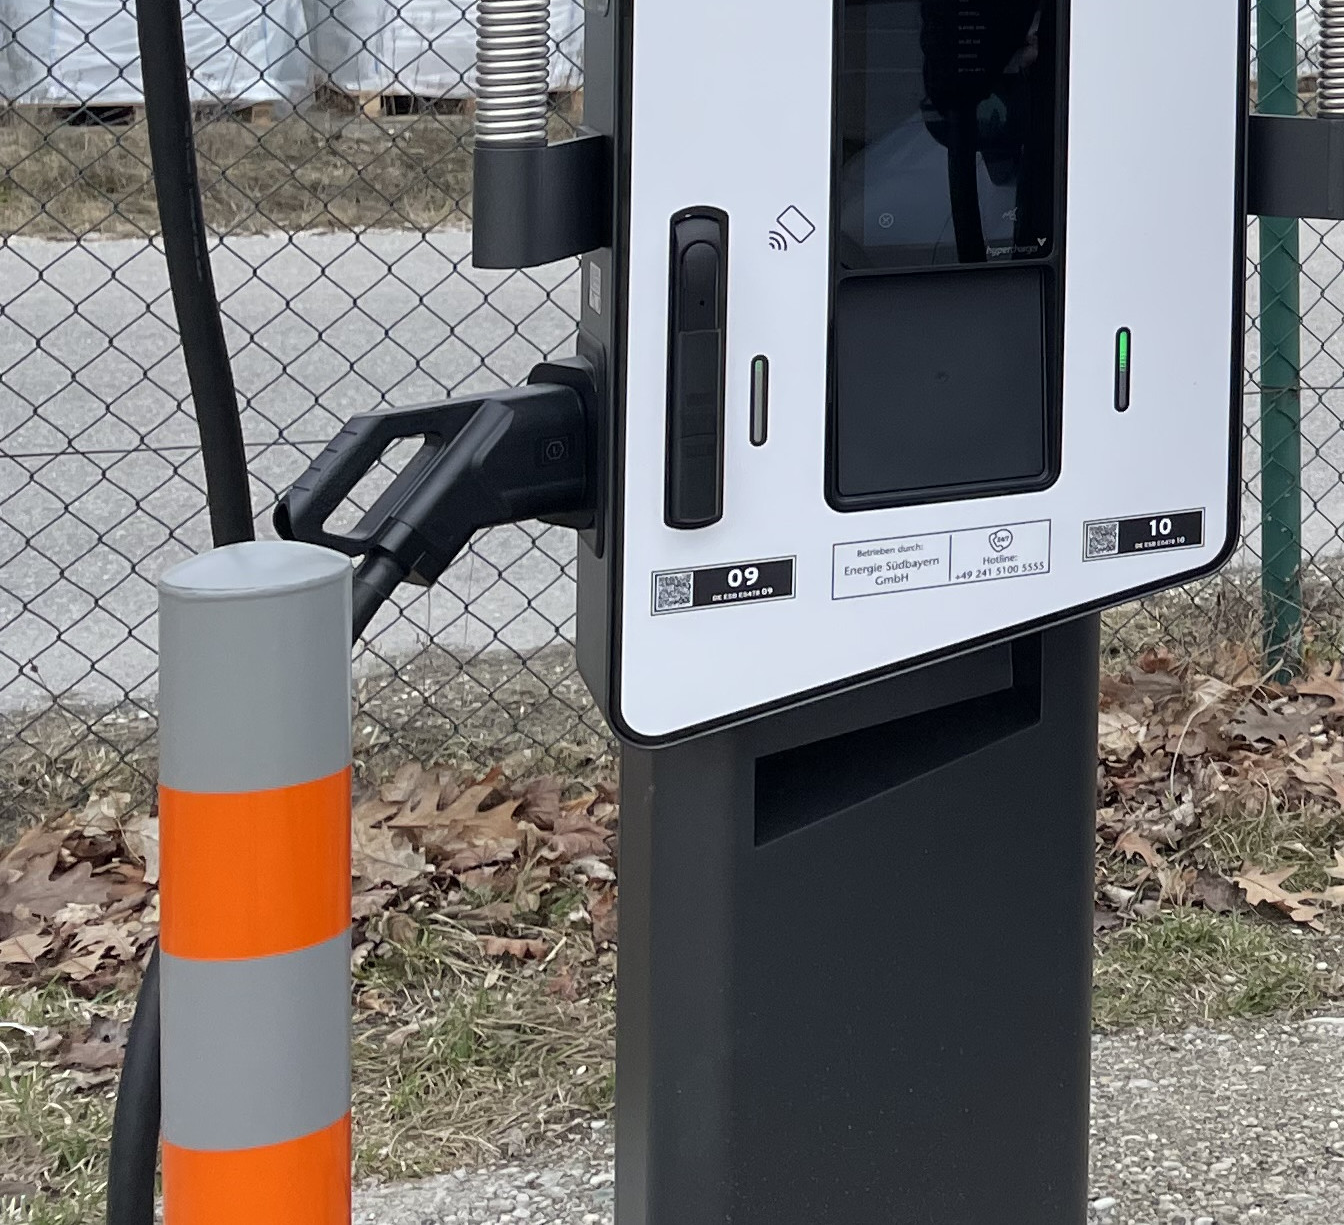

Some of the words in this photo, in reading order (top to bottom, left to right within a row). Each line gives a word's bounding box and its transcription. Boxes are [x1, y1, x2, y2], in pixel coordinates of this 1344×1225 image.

[1149, 518, 1172, 537] 10
[857, 547, 896, 557] Betrieben
[897, 543, 924, 553] durch:
[844, 563, 883, 576] Energie
[886, 557, 940, 572] Südbayern
[983, 554, 1018, 566] Hotline:
[728, 567, 759, 587] 09
[954, 571, 973, 581] +49
[975, 568, 992, 579] 241
[996, 564, 1019, 576] 5100
[1021, 561, 1045, 573] 5555
[875, 573, 909, 586] GmbH
[761, 587, 773, 595] 09
